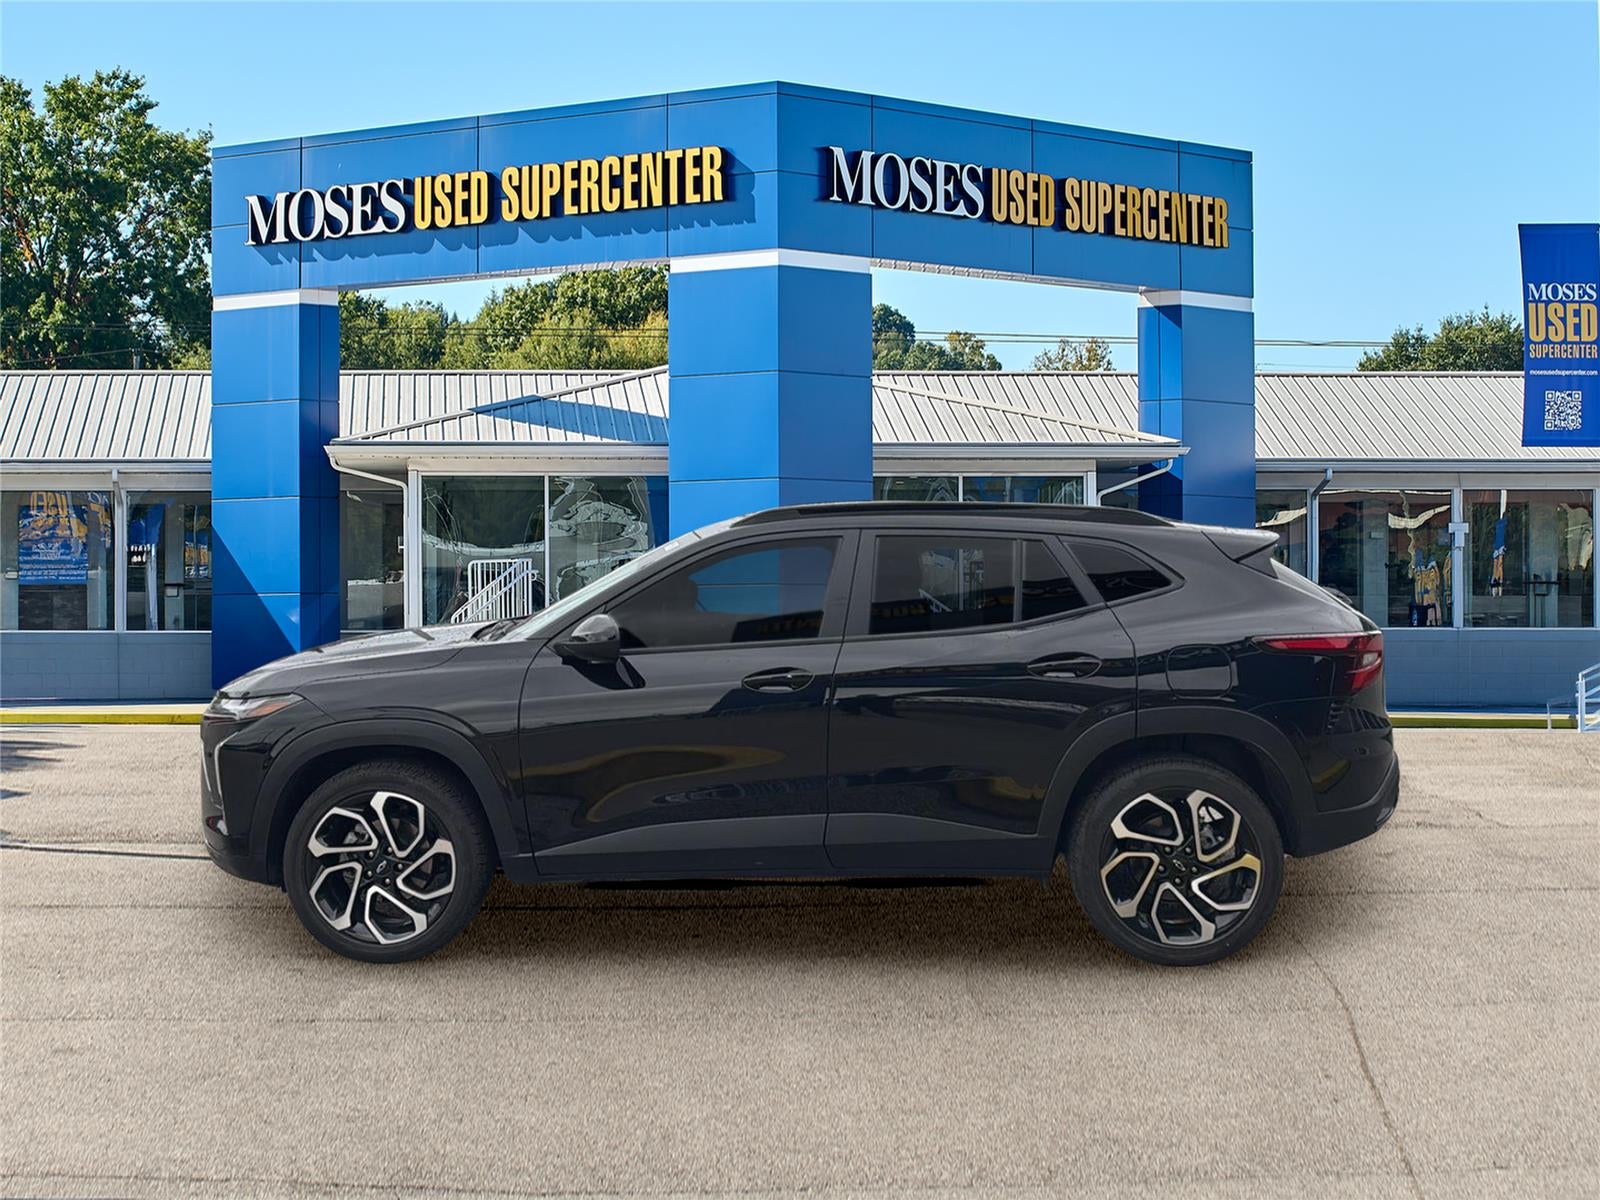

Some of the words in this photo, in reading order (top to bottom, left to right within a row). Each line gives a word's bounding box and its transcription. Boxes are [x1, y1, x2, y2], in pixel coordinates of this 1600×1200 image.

[245, 178, 407, 246] MOSES
[414, 171, 489, 230] USED
[501, 146, 723, 222] SUPERCENTER
[829, 146, 984, 219] MOSES
[992, 167, 1055, 227] USED
[1064, 177, 1230, 248] SUPERCENTER
[1528, 283, 1597, 301] MOSES
[1528, 303, 1597, 342] USED
[1530, 345, 1597, 359] SUPERCENTER
